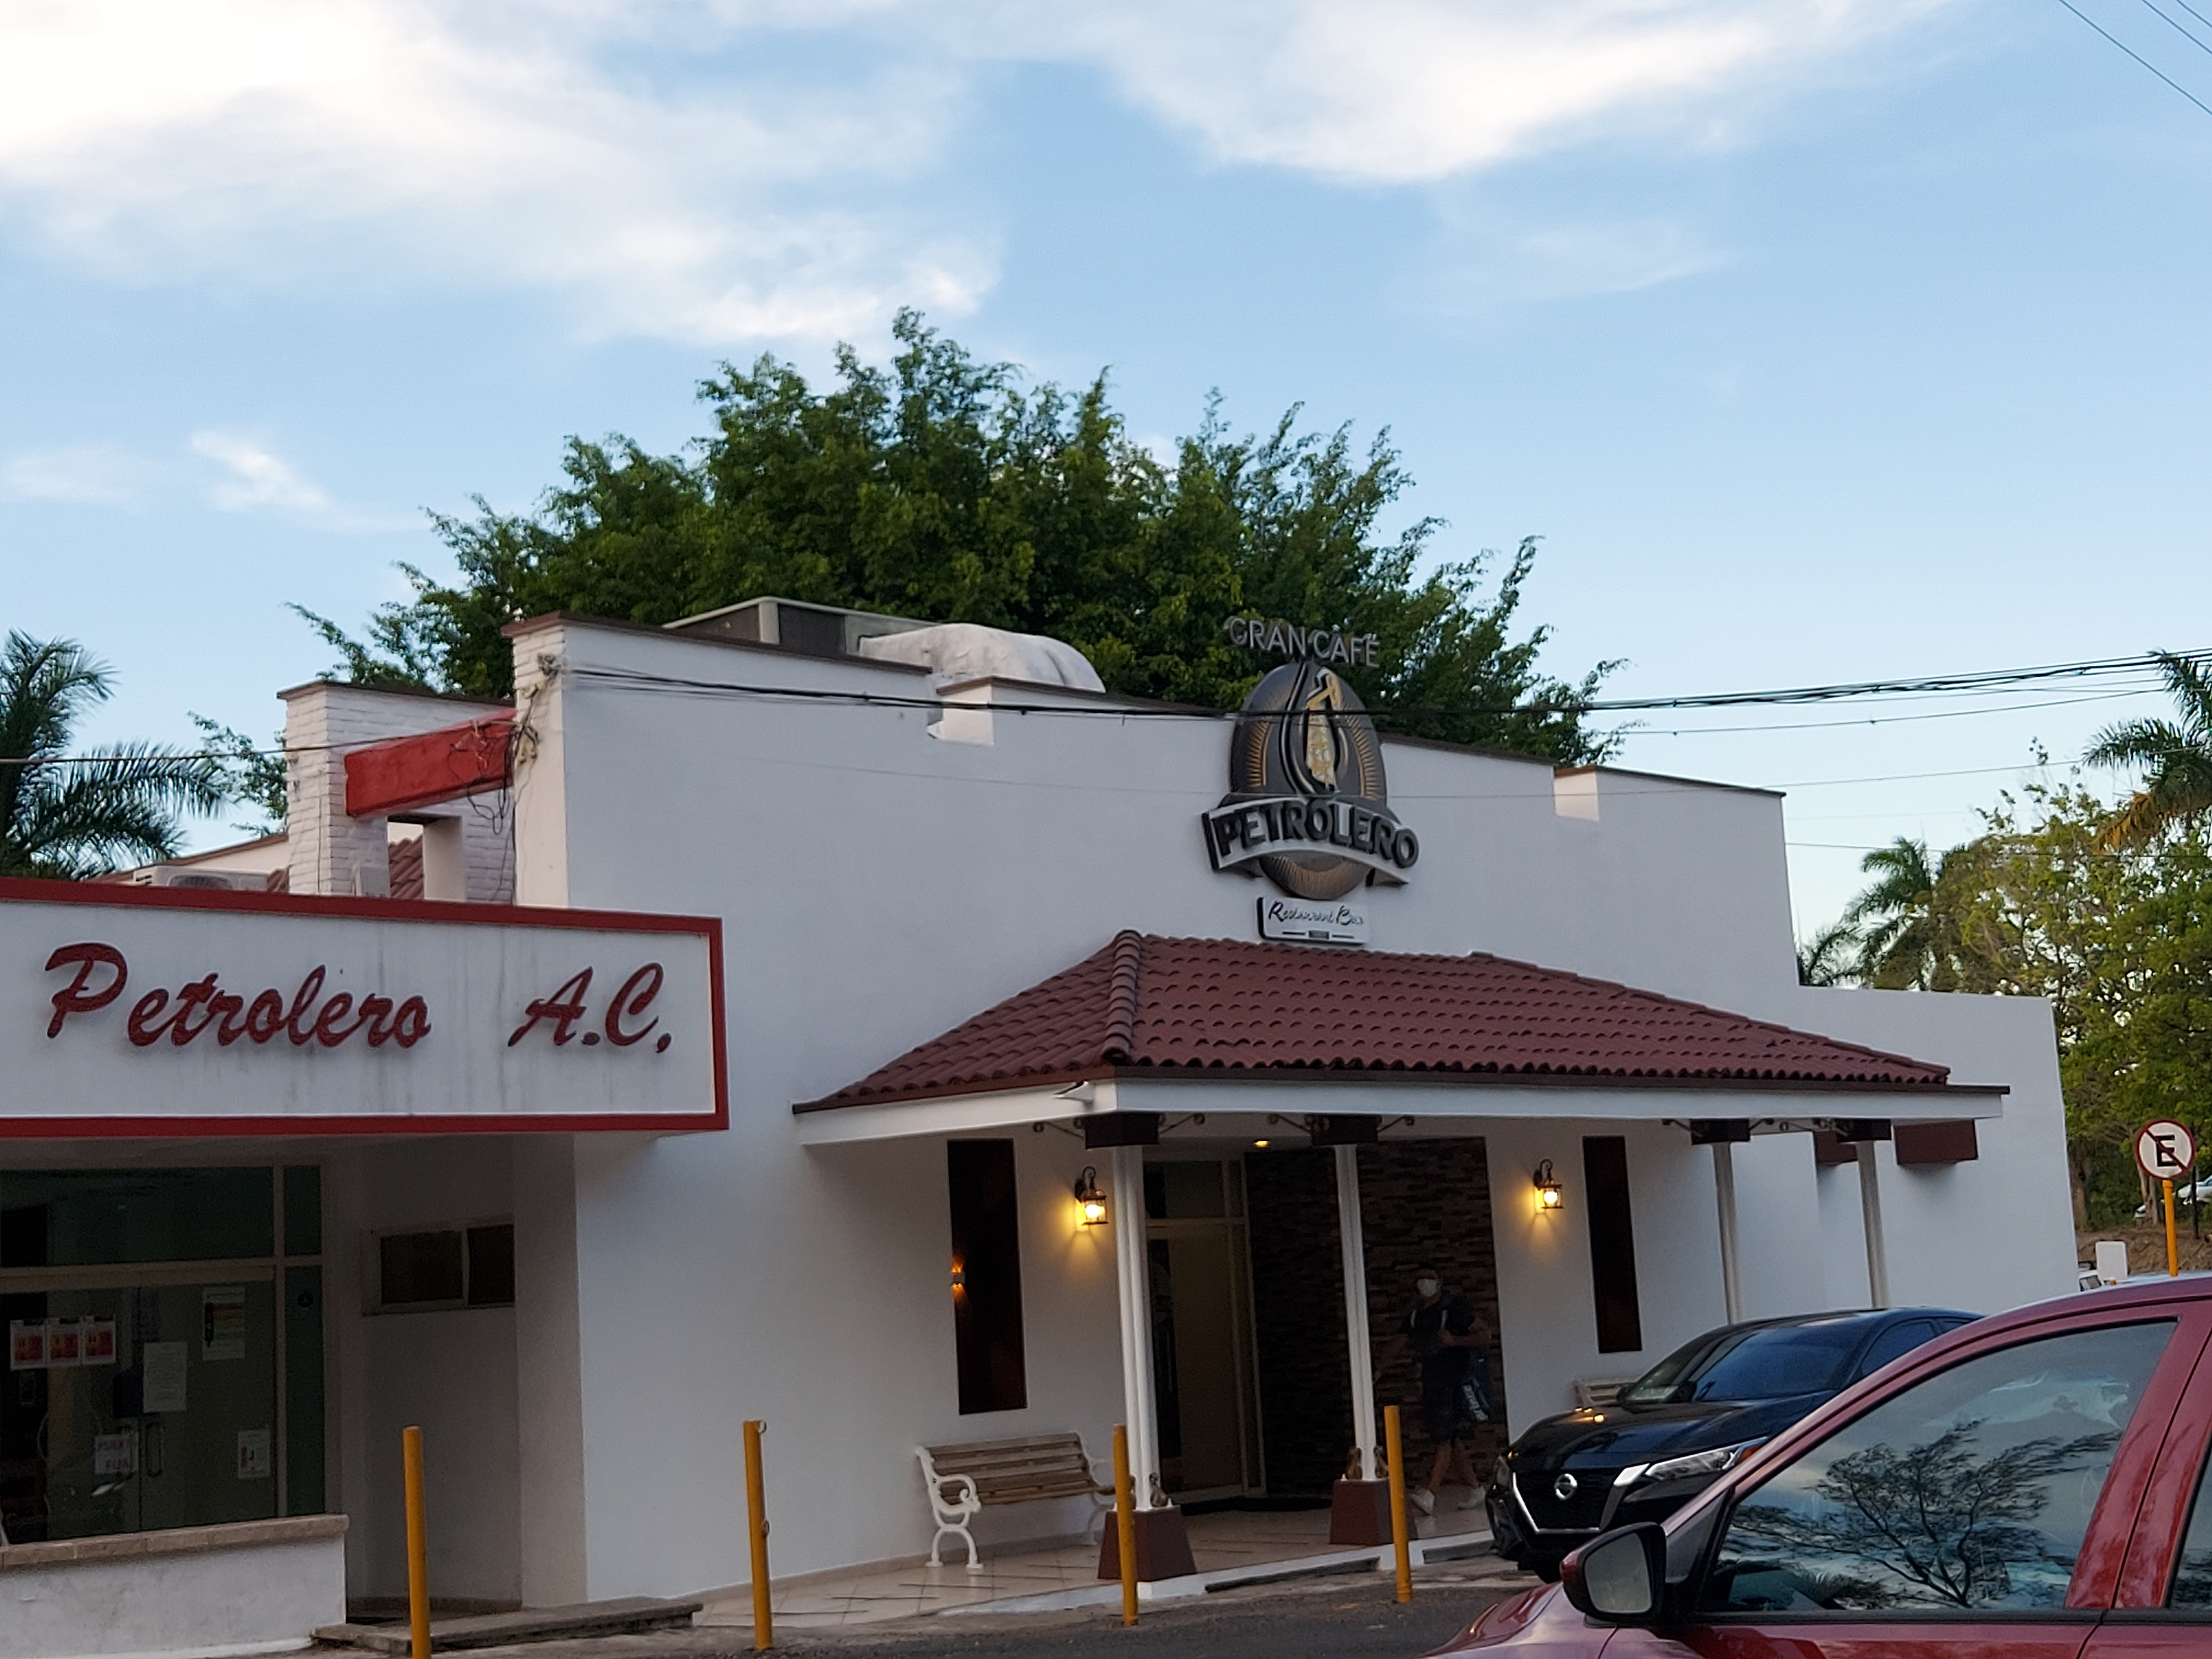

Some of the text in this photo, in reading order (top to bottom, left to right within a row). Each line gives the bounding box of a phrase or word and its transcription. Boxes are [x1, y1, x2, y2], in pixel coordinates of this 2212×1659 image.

[1224, 615, 1306, 657] GRAN
[1212, 799, 1420, 868] PETROLERO
[45, 942, 432, 1048] Petrolero
[2154, 1134, 2178, 1167] E
